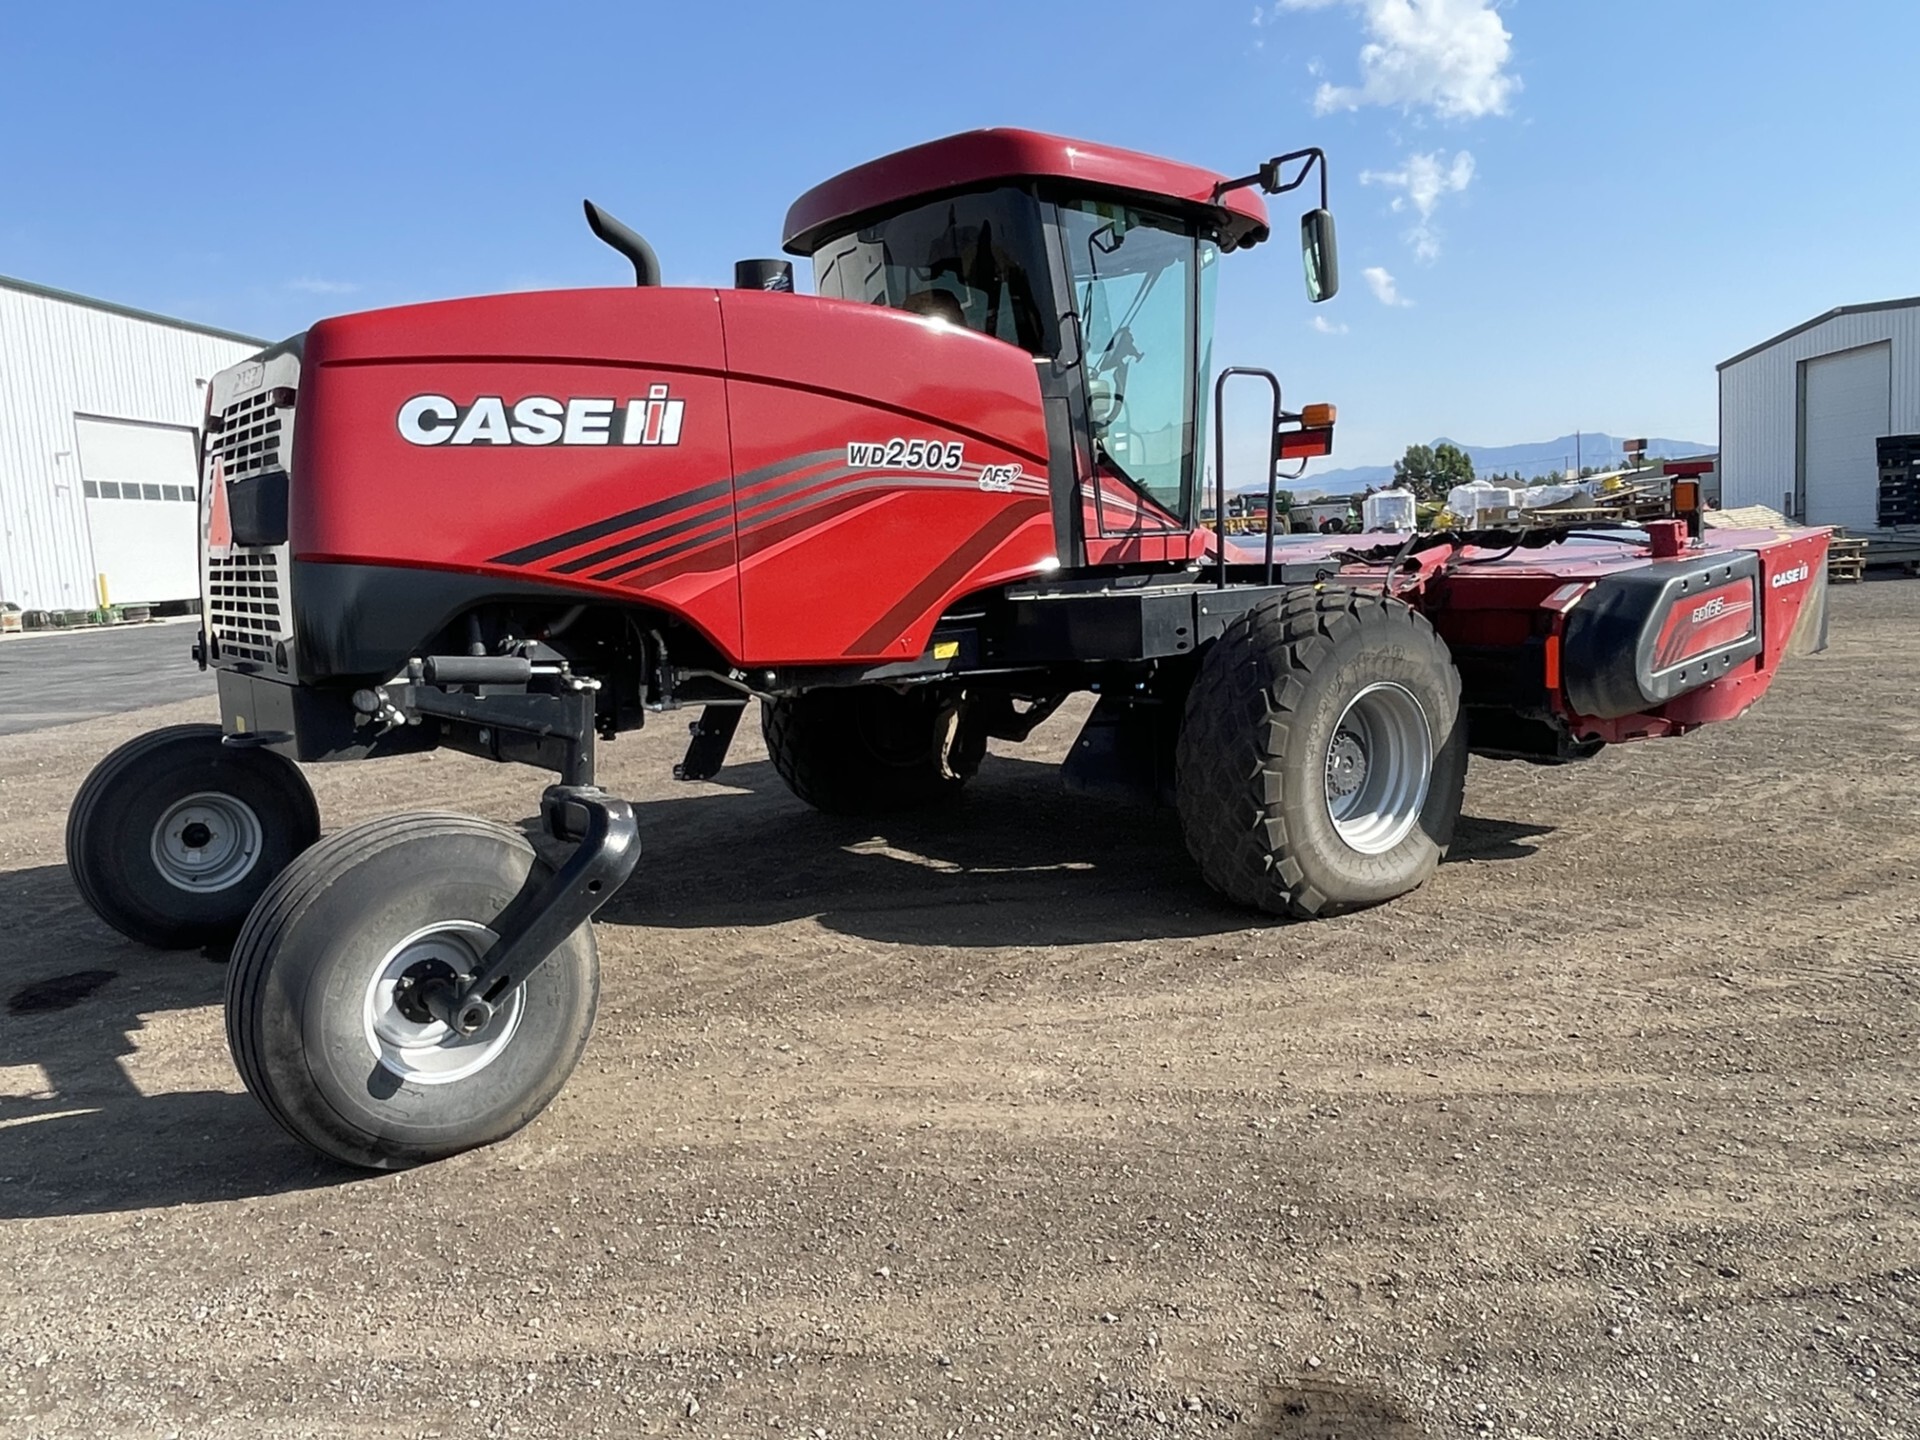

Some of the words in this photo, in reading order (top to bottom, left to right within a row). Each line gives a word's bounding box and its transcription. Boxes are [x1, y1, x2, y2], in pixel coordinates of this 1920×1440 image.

[397, 394, 615, 446] CASE
[849, 438, 964, 471] WD2505
[981, 466, 1013, 483] AFS
[1771, 567, 1800, 588] CASE
